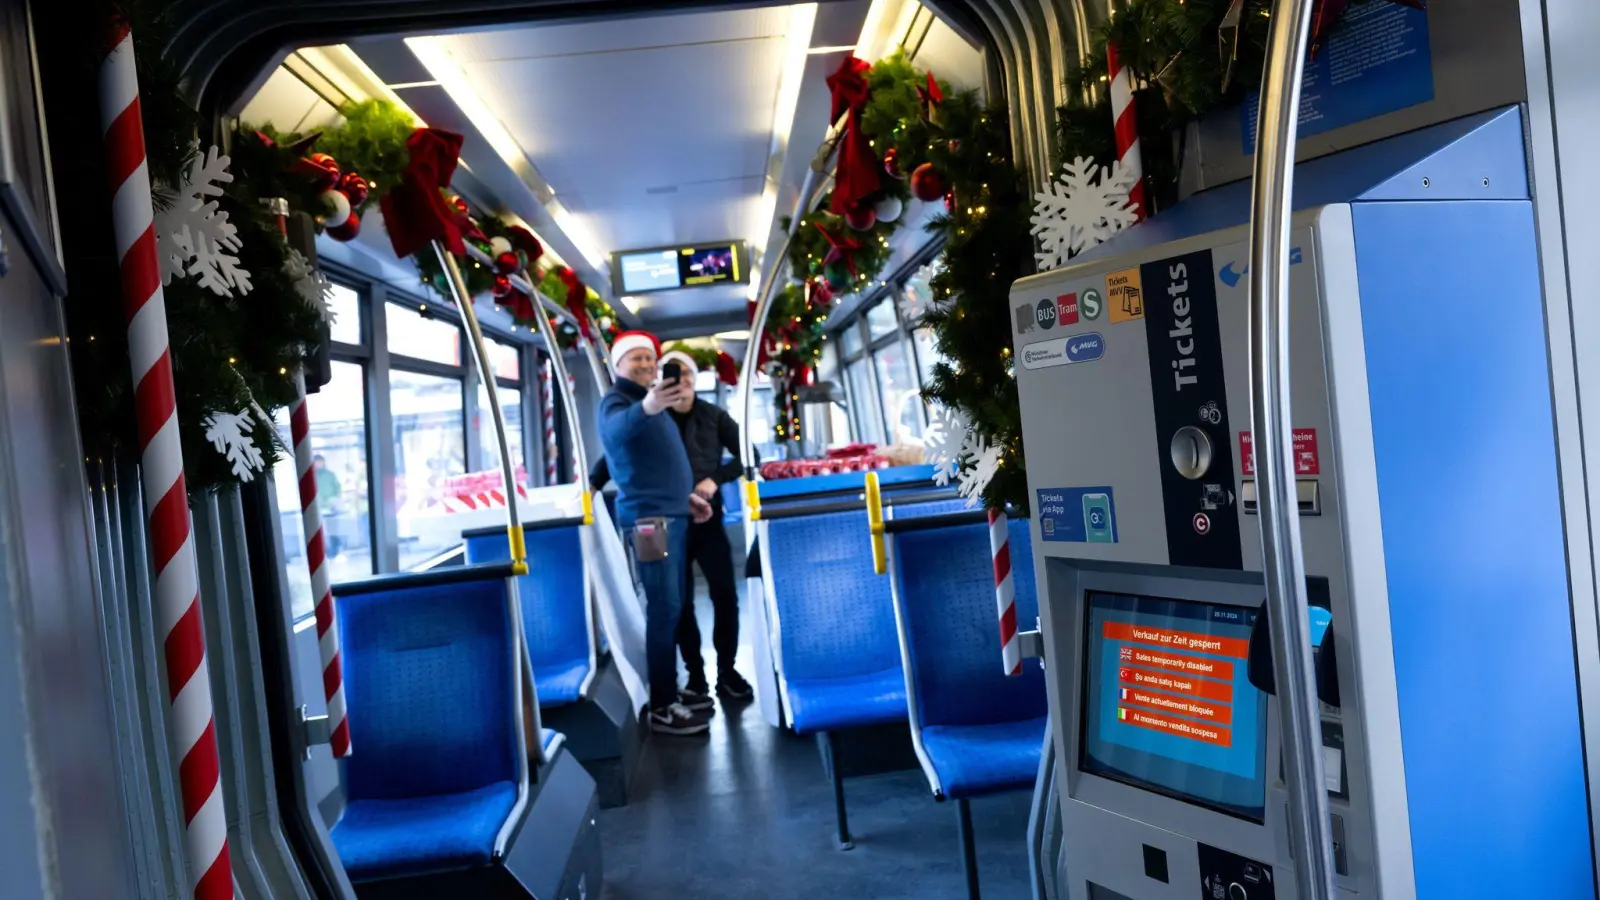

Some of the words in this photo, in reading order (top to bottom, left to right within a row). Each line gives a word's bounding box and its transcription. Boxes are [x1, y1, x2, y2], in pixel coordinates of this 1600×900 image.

[1109, 276, 1128, 286] Tickets
[1109, 287, 1123, 297] MVV
[1037, 306, 1056, 322] BUS
[1058, 303, 1078, 316] Tram
[1167, 263, 1198, 392] Tickets
[1079, 340, 1098, 350] MVG
[1293, 432, 1313, 441] heine
[1041, 494, 1064, 502] Tickets
[1052, 505, 1065, 515] App
[1133, 629, 1159, 641] Verkauf
[1160, 635, 1172, 643] zur
[1173, 635, 1188, 645] Zeit
[1189, 639, 1221, 650] gesperrt
[1136, 653, 1151, 662] Sales
[1152, 656, 1186, 669] temporarily
[1186, 661, 1213, 672] disabled
[1144, 675, 1158, 683] anda
[1134, 693, 1150, 703] Vente
[1151, 697, 1188, 711] actuellement
[1189, 704, 1214, 717] bloquée
[1133, 713, 1140, 721] Al
[1140, 716, 1168, 728] momento
[1168, 721, 1190, 733] vendita
[1191, 727, 1218, 739] sospesa
